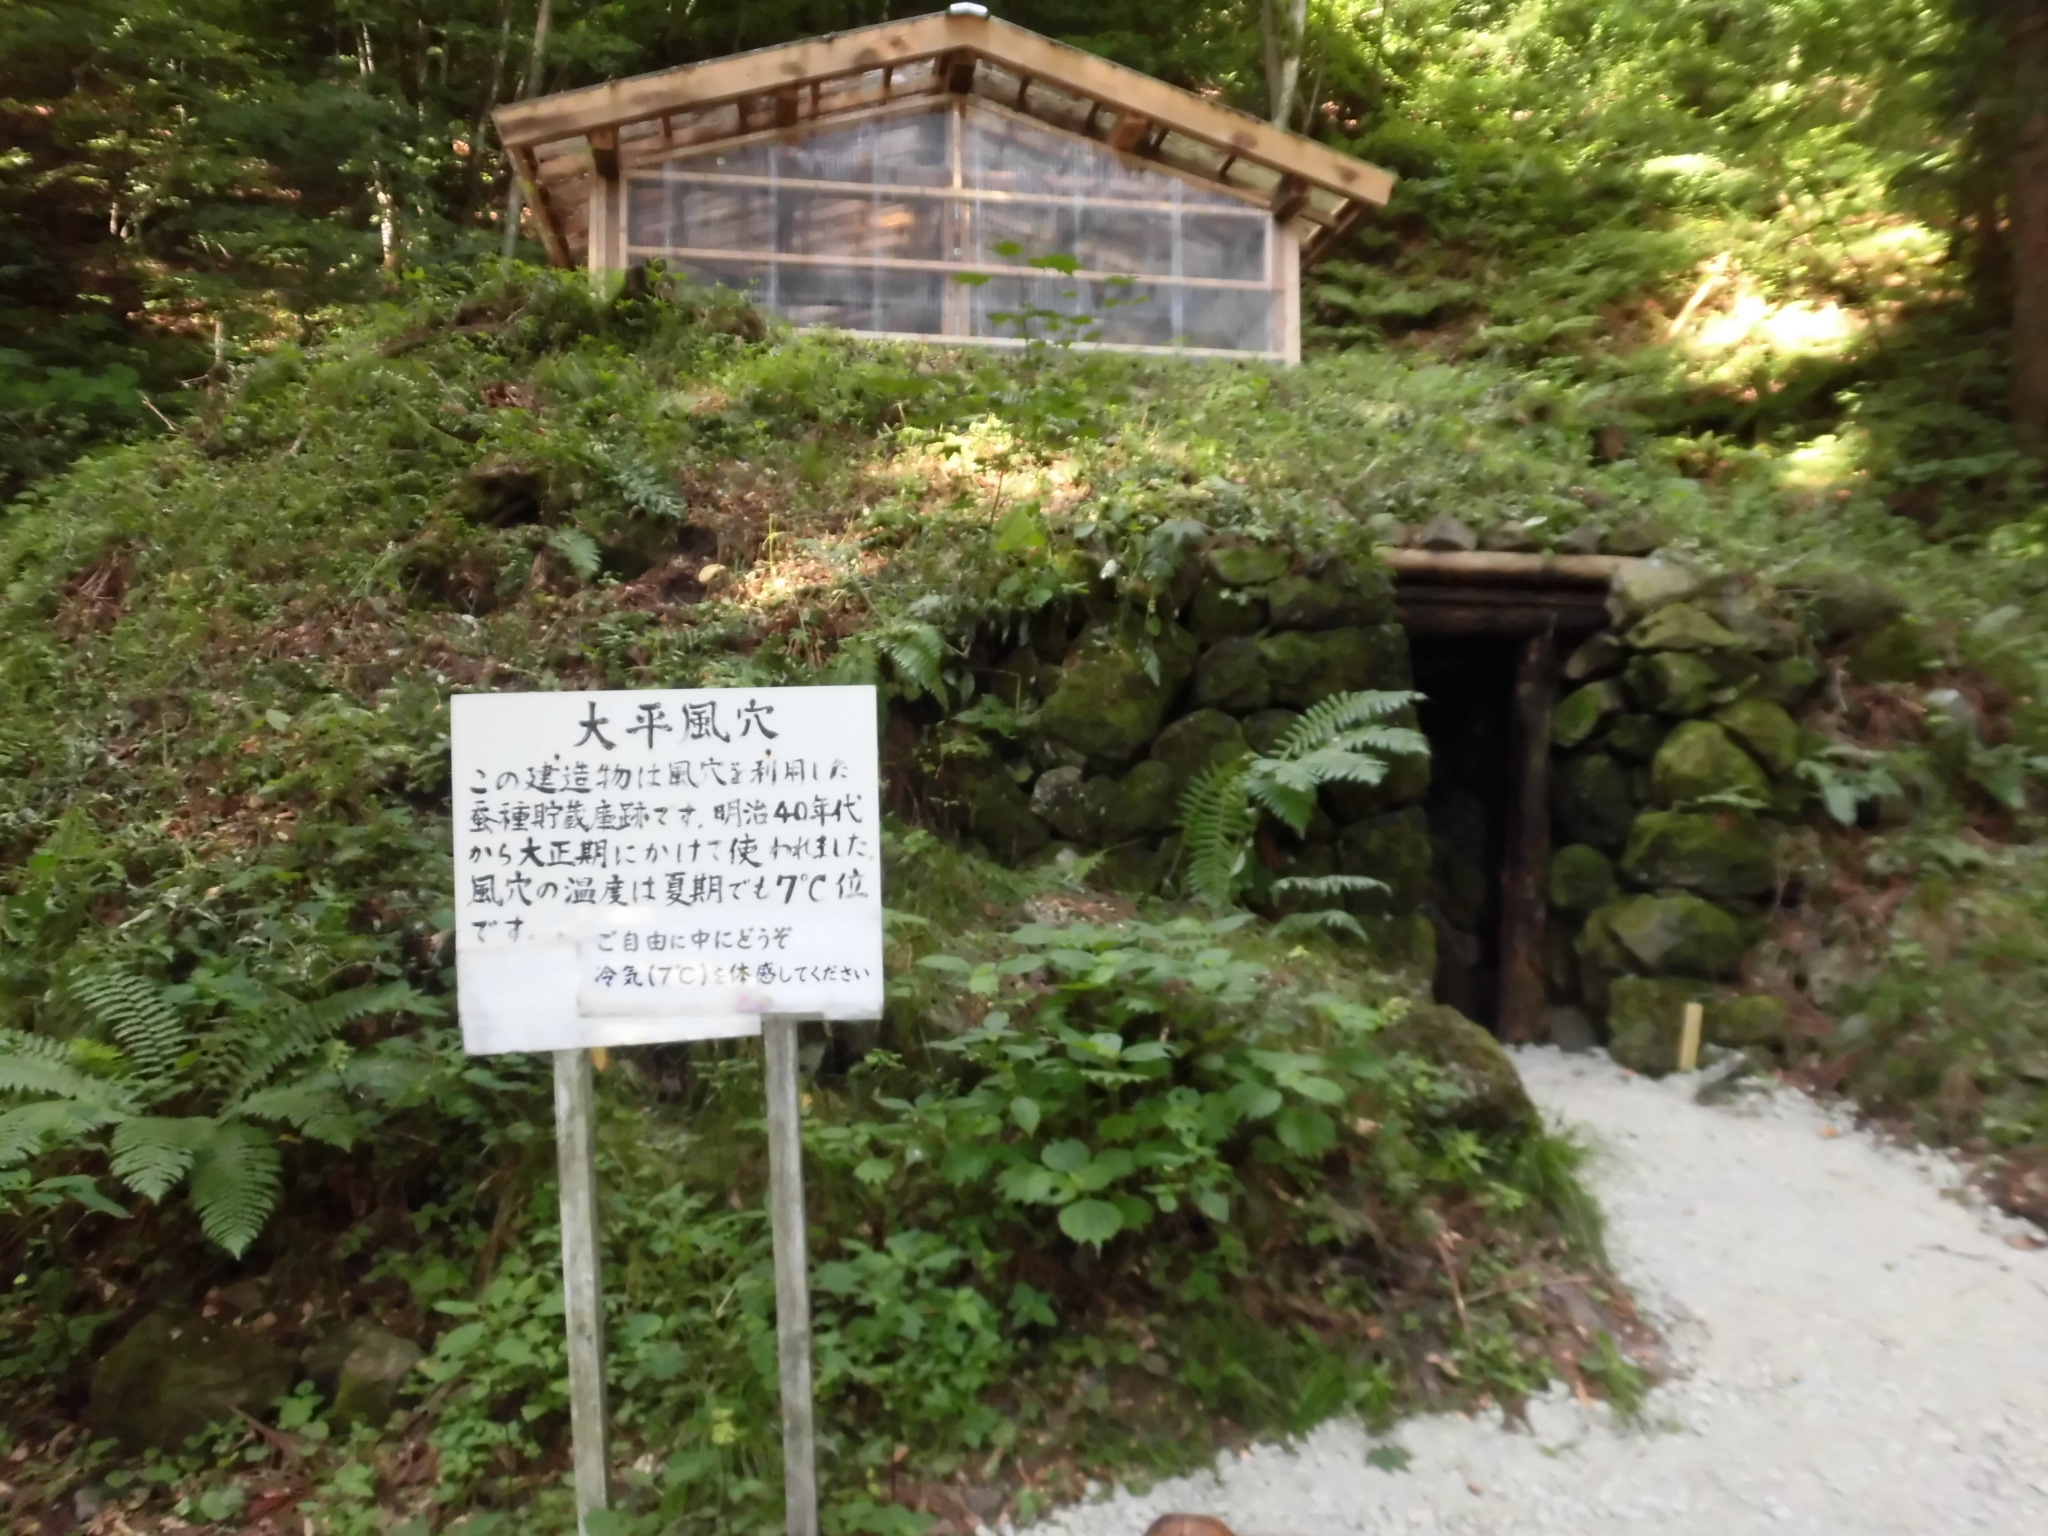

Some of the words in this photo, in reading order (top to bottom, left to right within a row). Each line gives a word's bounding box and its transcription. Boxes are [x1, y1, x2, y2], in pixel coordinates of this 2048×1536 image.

[573, 699, 779, 750] 大平風穴
[597, 926, 793, 952] ご自由に中にどうぞ
